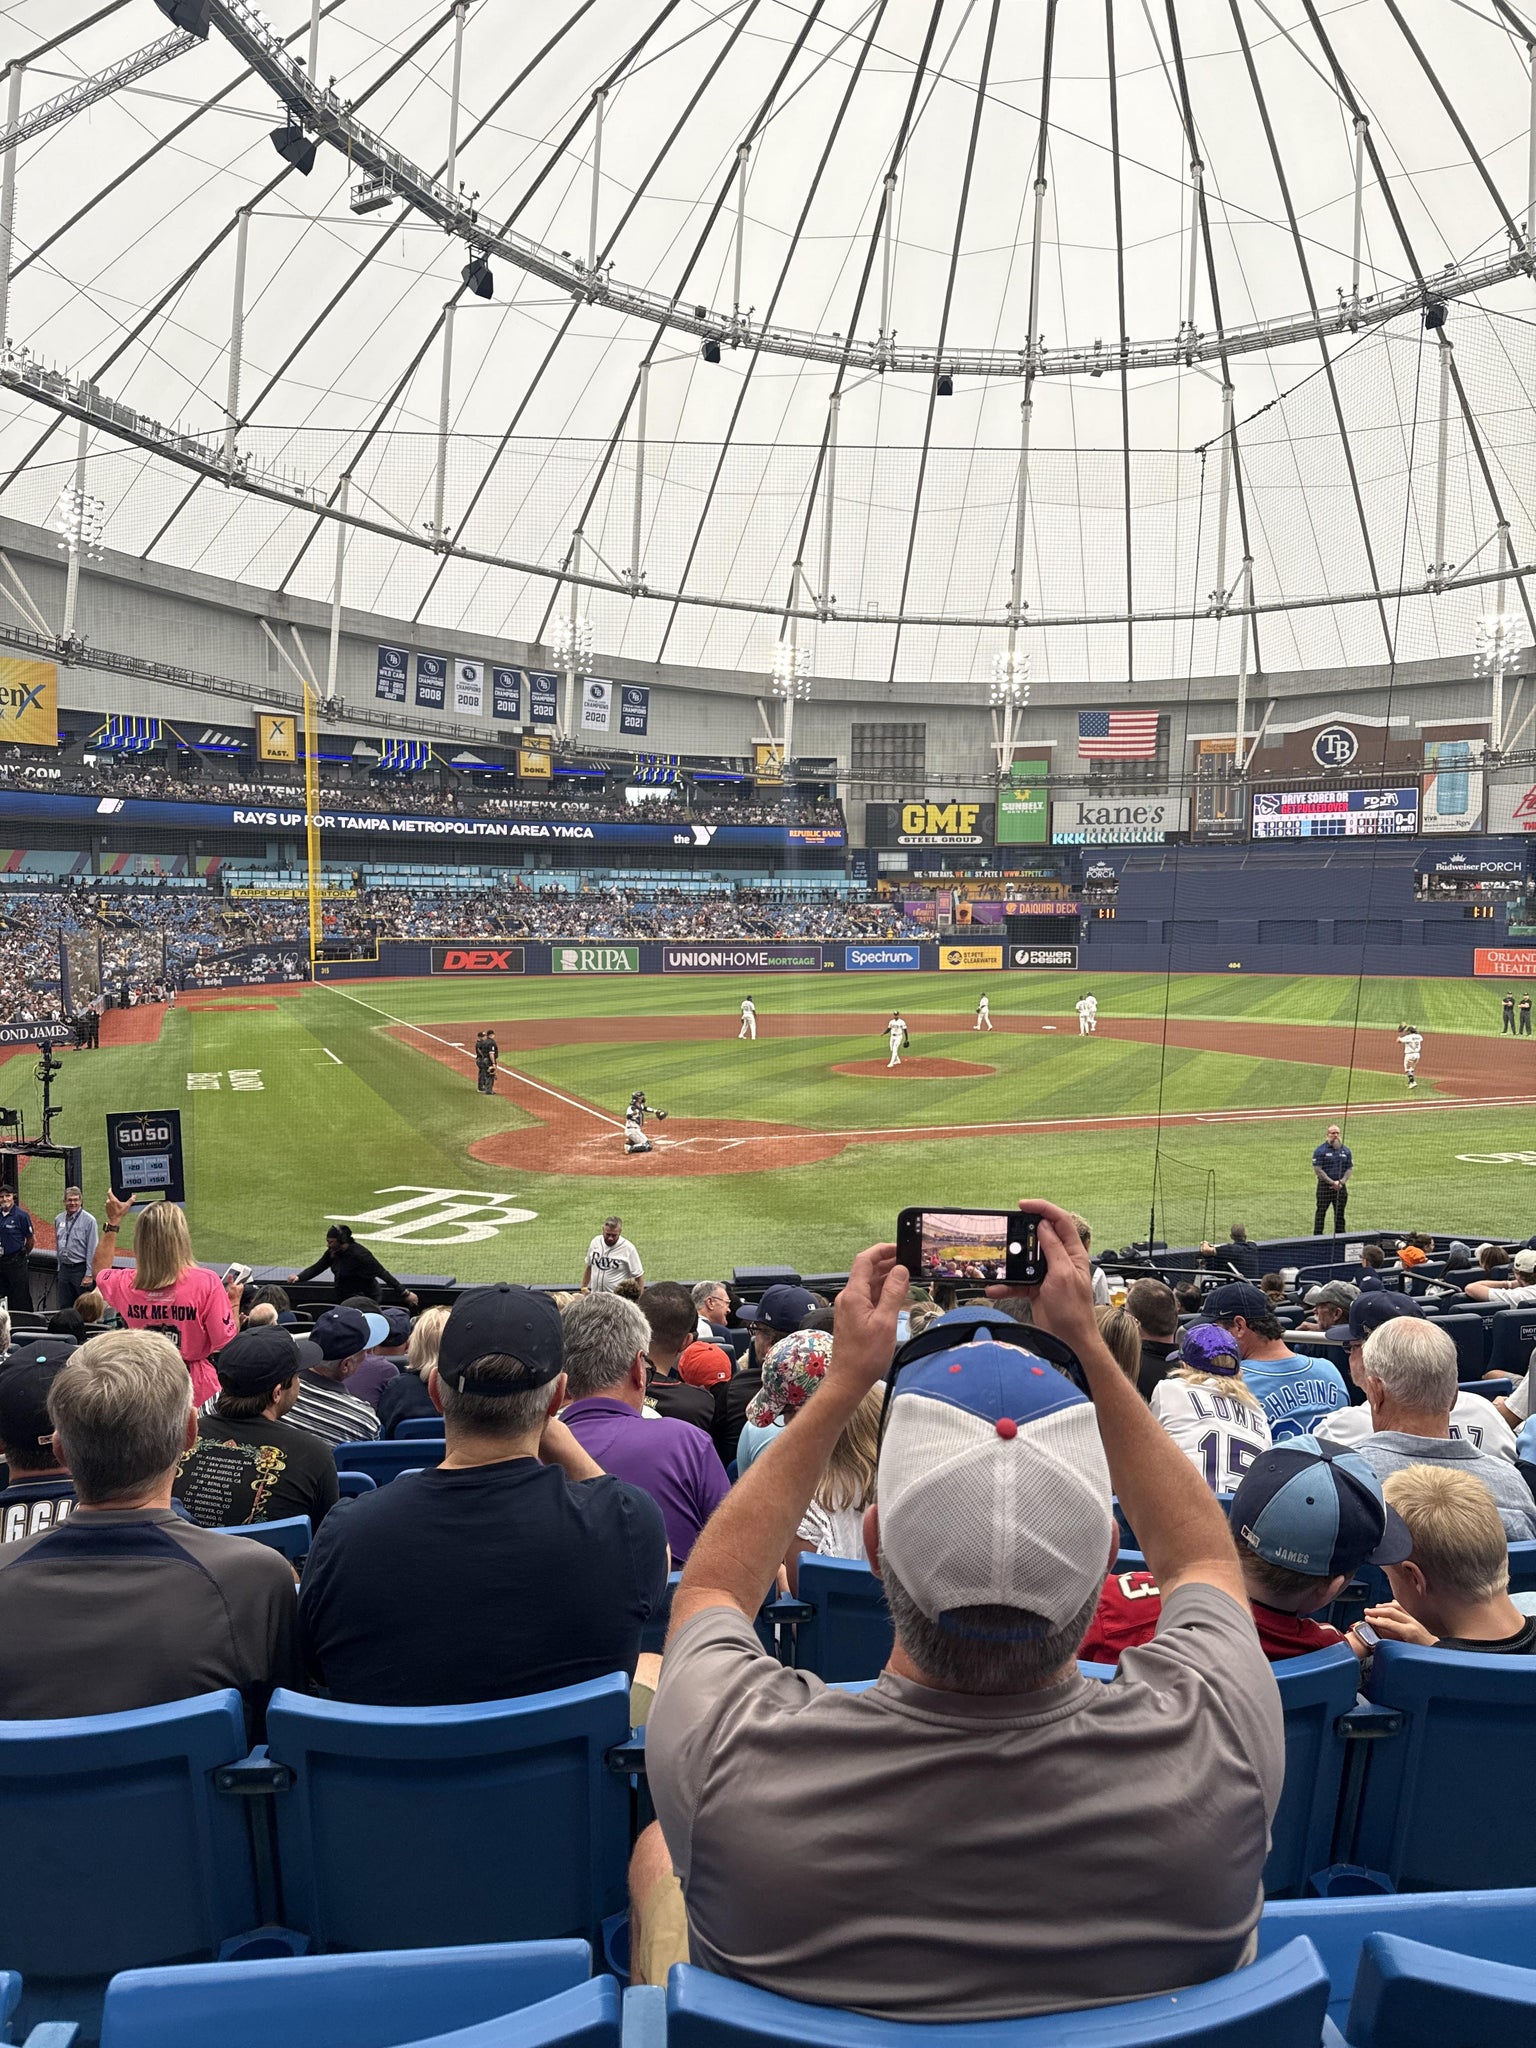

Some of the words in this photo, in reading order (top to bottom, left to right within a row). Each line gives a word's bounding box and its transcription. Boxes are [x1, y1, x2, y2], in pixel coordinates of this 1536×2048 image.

[420, 688, 442, 700] 2008
[458, 694, 480, 706] 2008
[496, 700, 516, 712] 2010
[534, 704, 554, 716] 2020
[586, 712, 606, 722] 2020
[624, 716, 644, 728] 2021
[1321, 734, 1350, 760] TB
[1282, 794, 1306, 804] DRIVE
[1307, 793, 1335, 804] SOBER
[1336, 792, 1349, 802] OR
[1076, 802, 1164, 826] kane's
[1282, 804, 1297, 814] GET
[1298, 803, 1327, 814] PULLED
[1328, 802, 1349, 813] OVER
[234, 811, 276, 825] RAYS
[280, 814, 301, 826] UP
[304, 815, 335, 828] FOR
[338, 817, 388, 831] TAMPA
[392, 820, 507, 835] METROPOLITAN
[510, 825, 550, 836] AREA
[552, 826, 594, 838] YMCA
[902, 804, 980, 834] GMF
[674, 834, 690, 844] the
[1480, 862, 1521, 872] PORCH
[1020, 904, 1054, 914] DAIQUIRI
[1057, 903, 1077, 913] DECK
[443, 951, 513, 970] DEX
[580, 950, 632, 971] RIPA
[852, 951, 908, 965] Spectrum
[30, 1026, 69, 1039] JAMES
[119, 1130, 143, 1142] 50
[146, 1127, 168, 1140] 50
[128, 1304, 148, 1319] ASK
[151, 1305, 169, 1320] ME
[171, 1306, 197, 1321] HOW
[1188, 1390, 1266, 1439] LOWE
[1198, 1430, 1265, 1494] 15
[1275, 1547, 1310, 1564] JAMES
